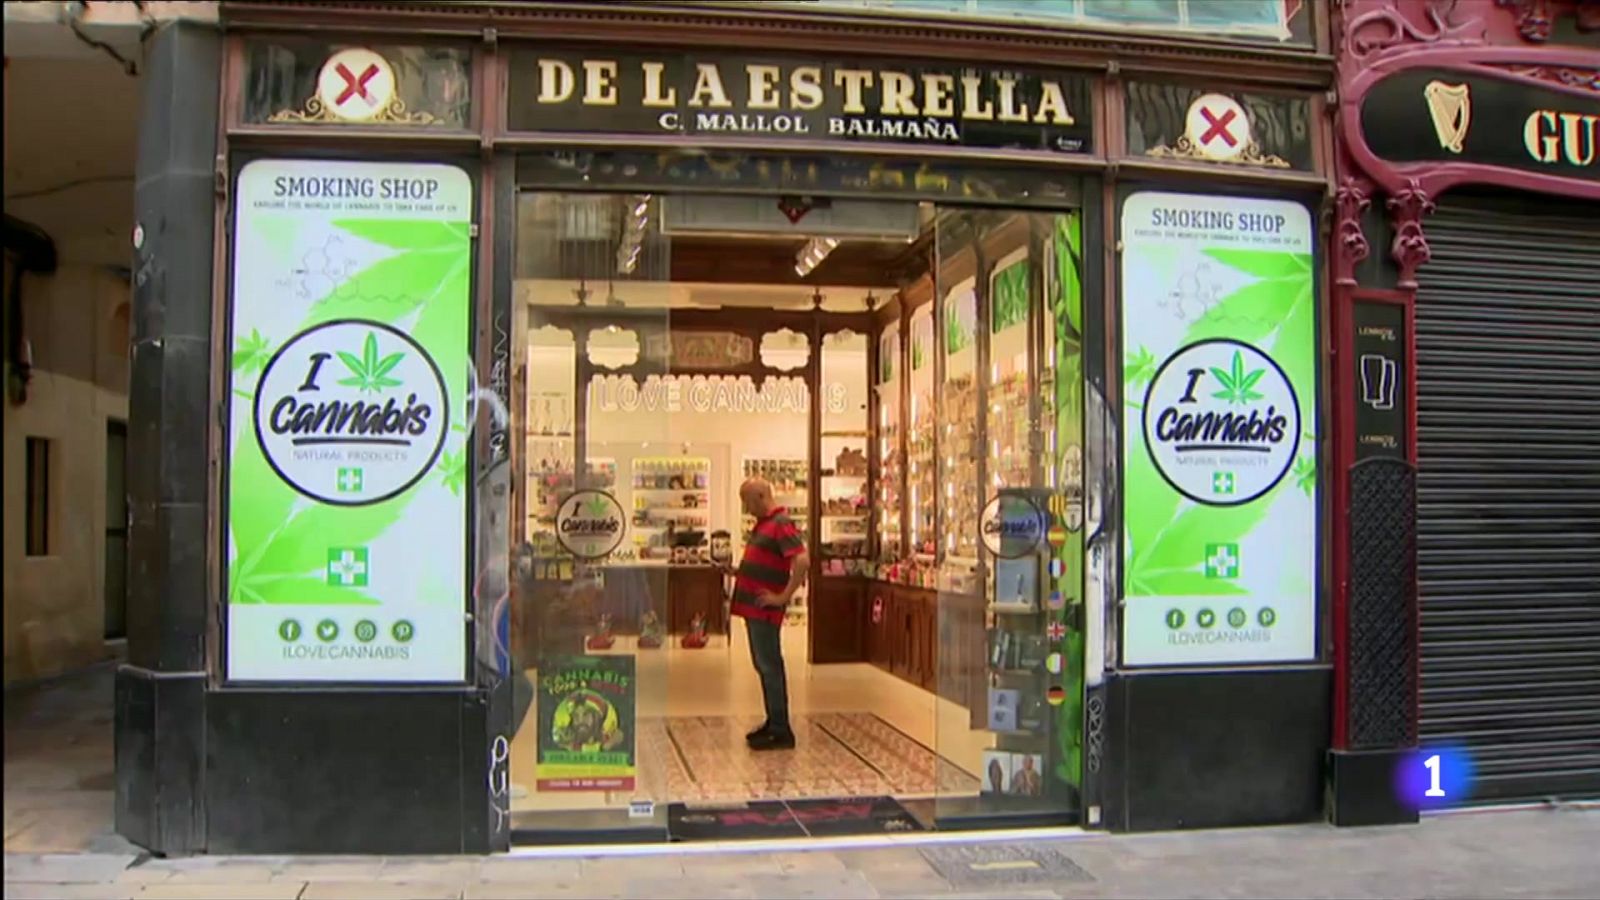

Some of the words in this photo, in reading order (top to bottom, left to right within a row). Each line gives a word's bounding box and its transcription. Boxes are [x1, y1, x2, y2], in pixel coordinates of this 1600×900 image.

[537, 58, 617, 105] DE
[642, 62, 732, 107] LA
[745, 65, 1075, 125] ESTRELLA
[659, 112, 684, 131] C.
[697, 113, 809, 133] MALLOL
[828, 117, 960, 140] BALMAÑA
[274, 176, 374, 198] SMOKING
[380, 179, 439, 199] SHOP
[1152, 207, 1233, 231] SMOKING
[1239, 213, 1286, 233] SHOP
[298, 352, 332, 392] I
[1178, 368, 1206, 403] I
[269, 393, 431, 435] Cannabis
[1156, 405, 1287, 443] Cannabis
[293, 450, 342, 461] NATURAL
[347, 450, 409, 462] PRODUCTS
[282, 645, 410, 660] ILOVECANNABIS
